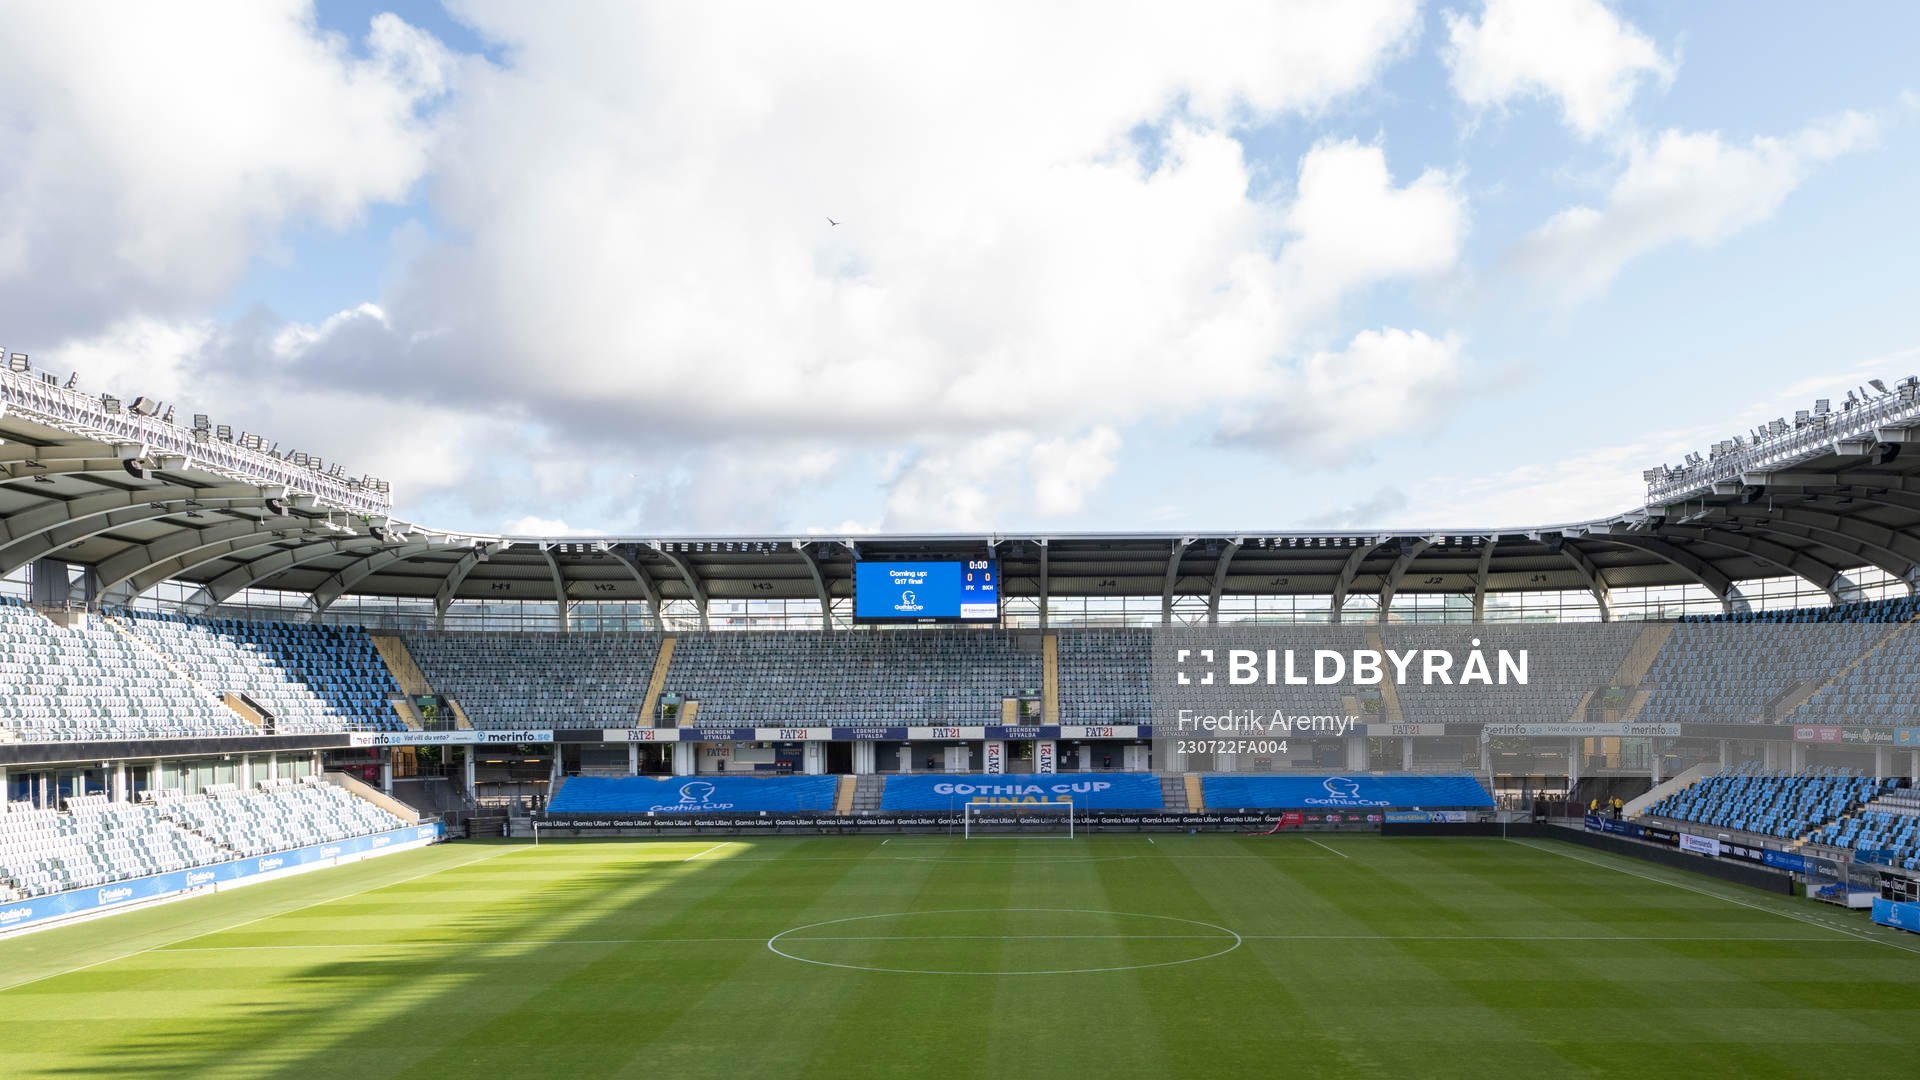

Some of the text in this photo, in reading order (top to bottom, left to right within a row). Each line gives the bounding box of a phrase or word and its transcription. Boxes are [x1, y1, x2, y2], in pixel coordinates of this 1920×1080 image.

[969, 561, 988, 569] 0:00
[967, 573, 990, 582] 0 0
[1424, 576, 1443, 584] J2
[780, 730, 807, 739] FAT21
[932, 728, 960, 738] FAT21
[1085, 728, 1113, 737] FAT21
[1392, 725, 1420, 735] FAT21
[1631, 724, 1678, 735] merinfo.se
[488, 731, 550, 741] merinfo.se
[628, 731, 655, 740] FAT21
[707, 748, 729, 756] FAT21
[989, 743, 1000, 774] FAT21
[1041, 743, 1051, 774] FAT21
[934, 782, 1110, 795] GOTHIA CUP
[972, 796, 1073, 807] FINALS
